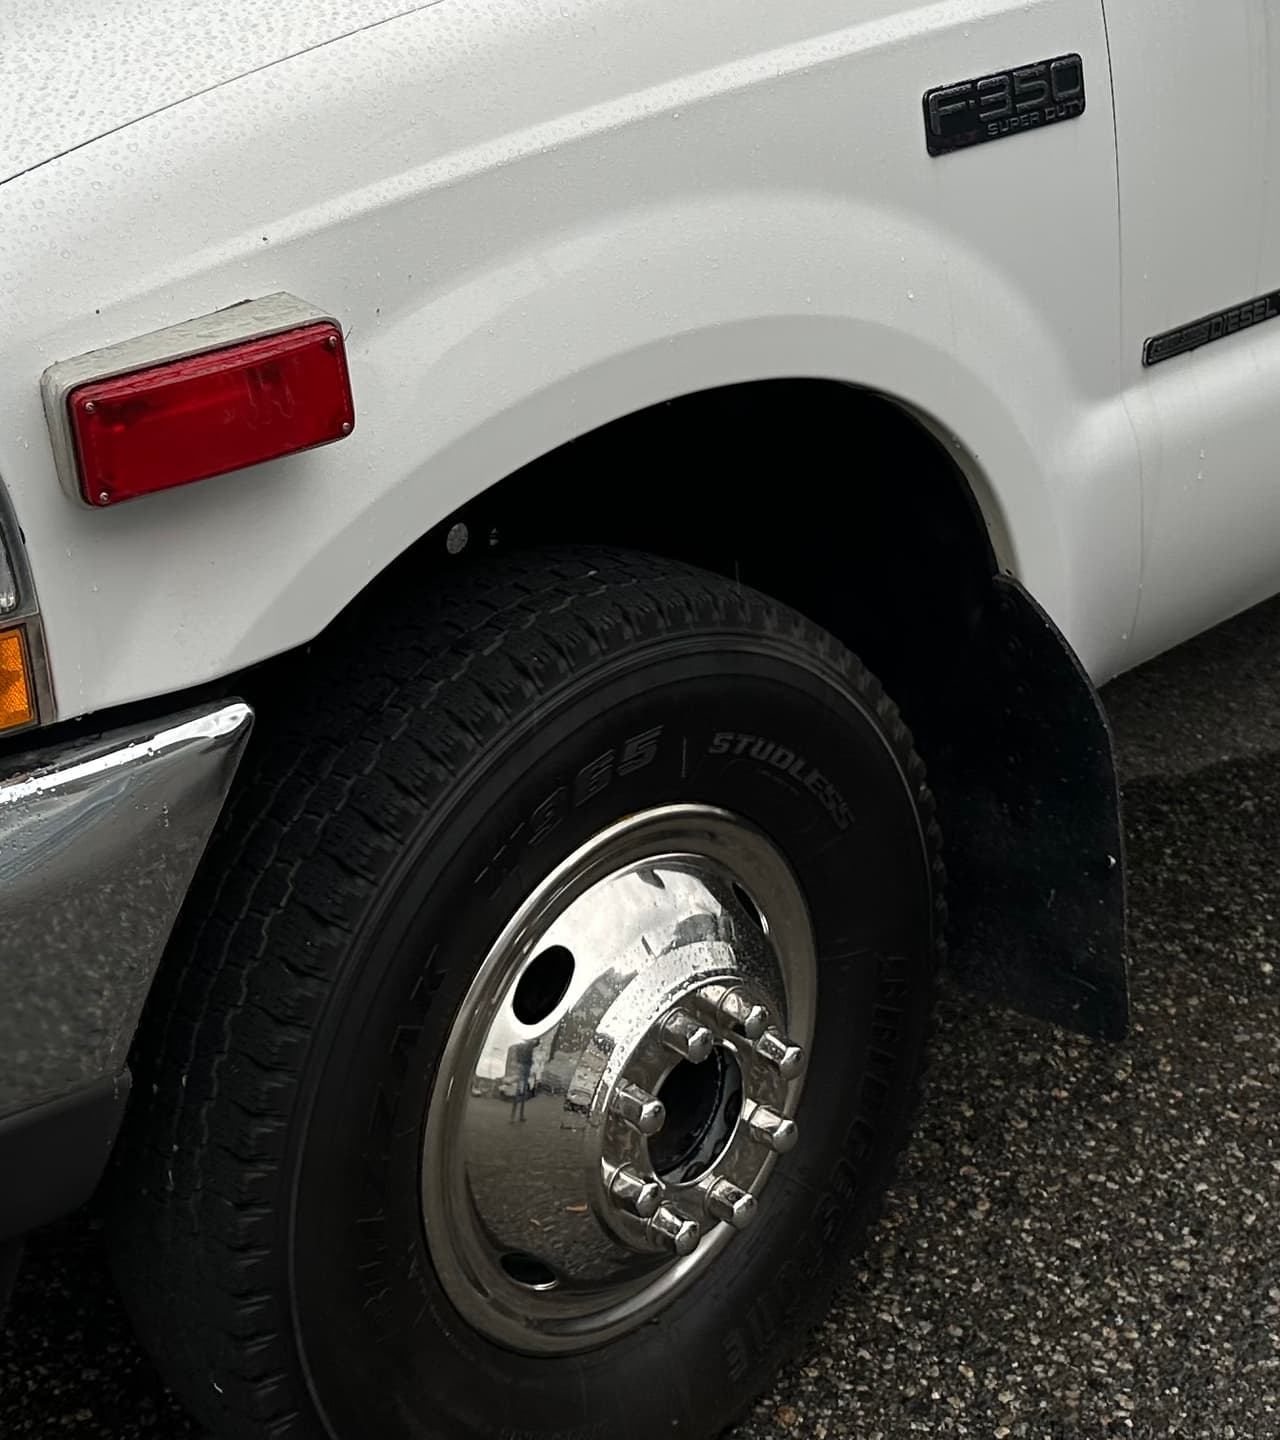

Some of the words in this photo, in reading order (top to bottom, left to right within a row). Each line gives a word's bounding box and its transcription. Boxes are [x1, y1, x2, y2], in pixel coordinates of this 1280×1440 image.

[987, 111, 1041, 136] SUPER
[1044, 98, 1084, 121] DUTY
[1210, 297, 1278, 338] DIESEL
[705, 731, 857, 832] STUDLESS
